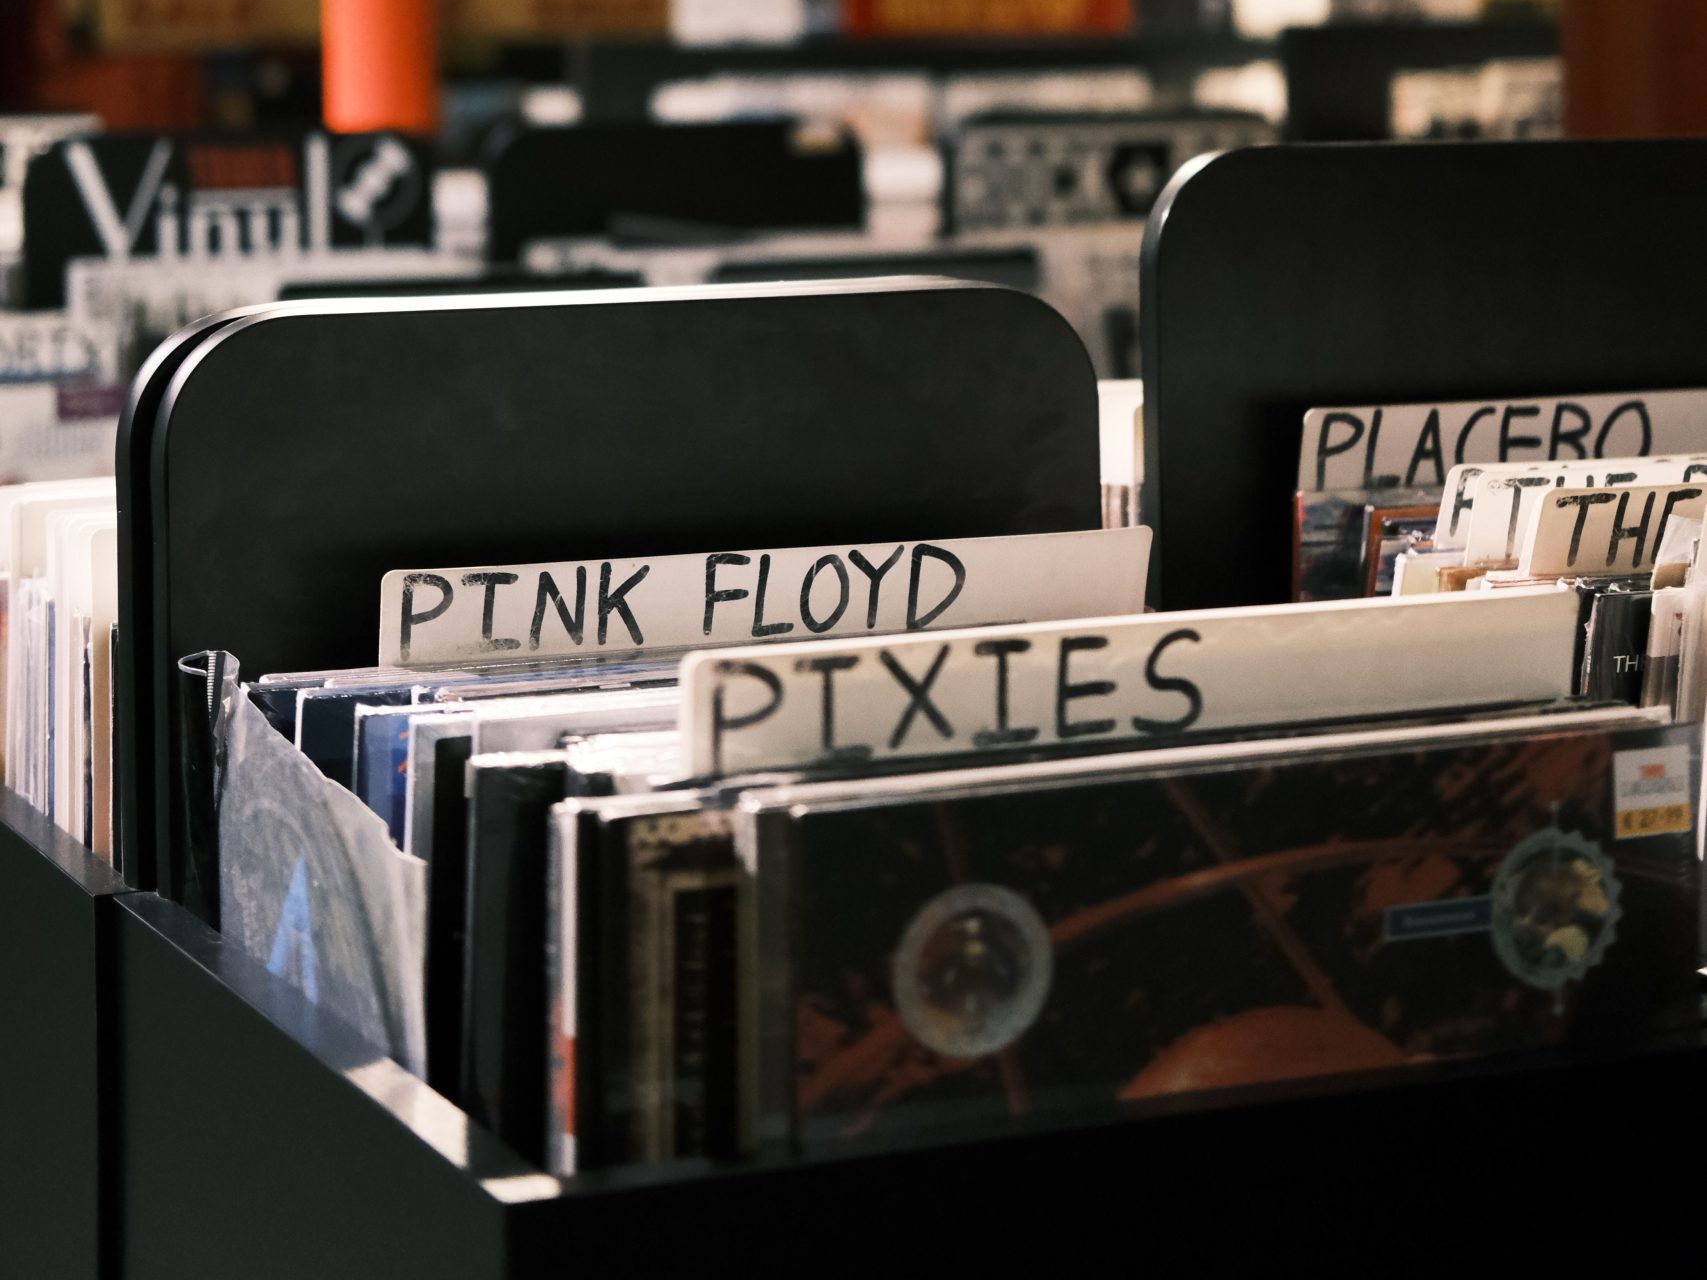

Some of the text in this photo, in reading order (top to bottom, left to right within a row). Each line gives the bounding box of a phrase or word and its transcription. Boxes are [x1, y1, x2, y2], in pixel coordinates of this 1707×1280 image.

[1315, 399, 1652, 492] PLACEBO
[400, 542, 966, 662] PINK FLOYD
[710, 627, 1203, 776] PIXIES
[1612, 654, 1643, 673] TH
